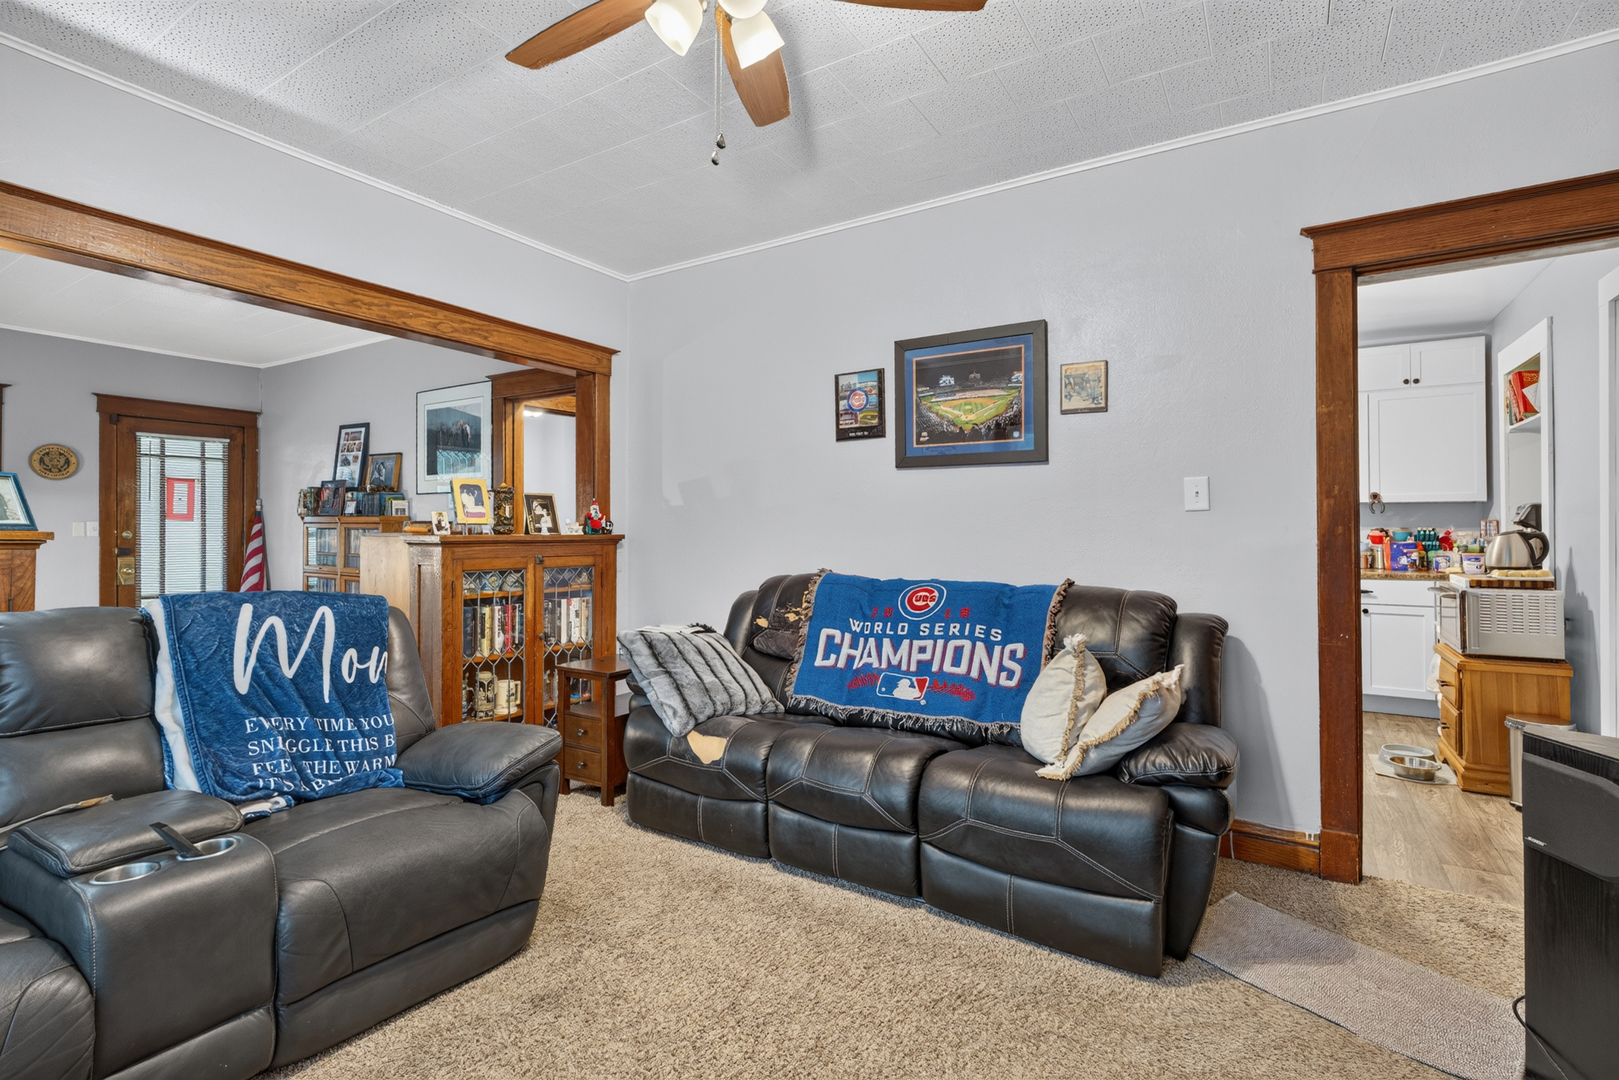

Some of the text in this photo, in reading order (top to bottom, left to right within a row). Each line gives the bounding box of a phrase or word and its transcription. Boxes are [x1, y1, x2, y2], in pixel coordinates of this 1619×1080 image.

[849, 617, 1002, 641] WORLD SERIES
[814, 628, 1027, 689] CHAMPIONS
[313, 717, 357, 732] TIME
[359, 713, 395, 730] YOU
[337, 736, 379, 752] THIS
[252, 758, 297, 775] FEE
[302, 760, 341, 775] THE
